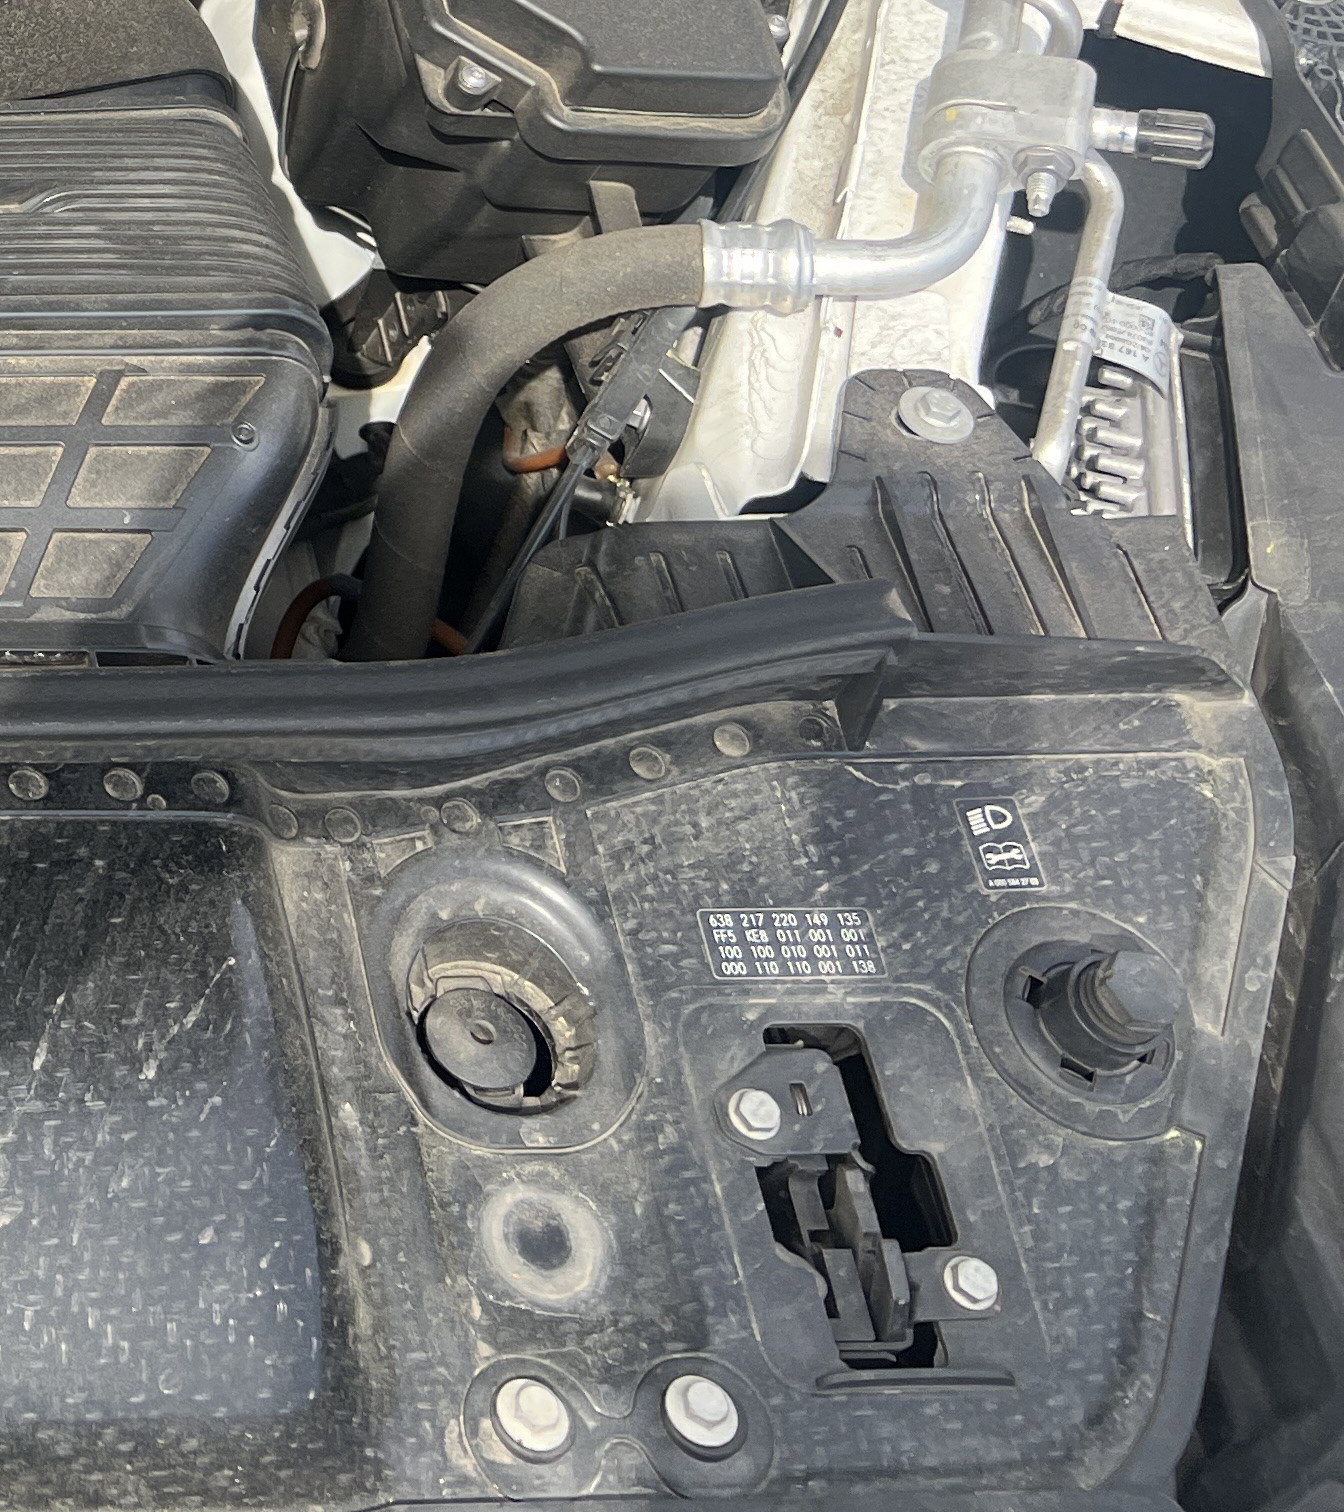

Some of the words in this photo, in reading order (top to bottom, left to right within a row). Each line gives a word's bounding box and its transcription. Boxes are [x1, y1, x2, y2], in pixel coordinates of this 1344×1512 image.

[708, 913, 734, 928] 638
[739, 913, 764, 928] 217
[771, 913, 797, 928] 220
[805, 912, 829, 927] 149
[837, 912, 862, 926] 135
[776, 929, 801, 943] 011
[808, 929, 834, 943] 001
[840, 928, 866, 942] 001
[718, 945, 743, 959] 100
[750, 945, 775, 959] 100
[780, 945, 807, 959] 010
[813, 945, 838, 959] 001
[845, 944, 871, 958] 011
[721, 961, 747, 975] 000
[754, 961, 780, 975] 110
[786, 961, 812, 975] 110
[818, 961, 843, 974] 001
[851, 960, 877, 974] 138
